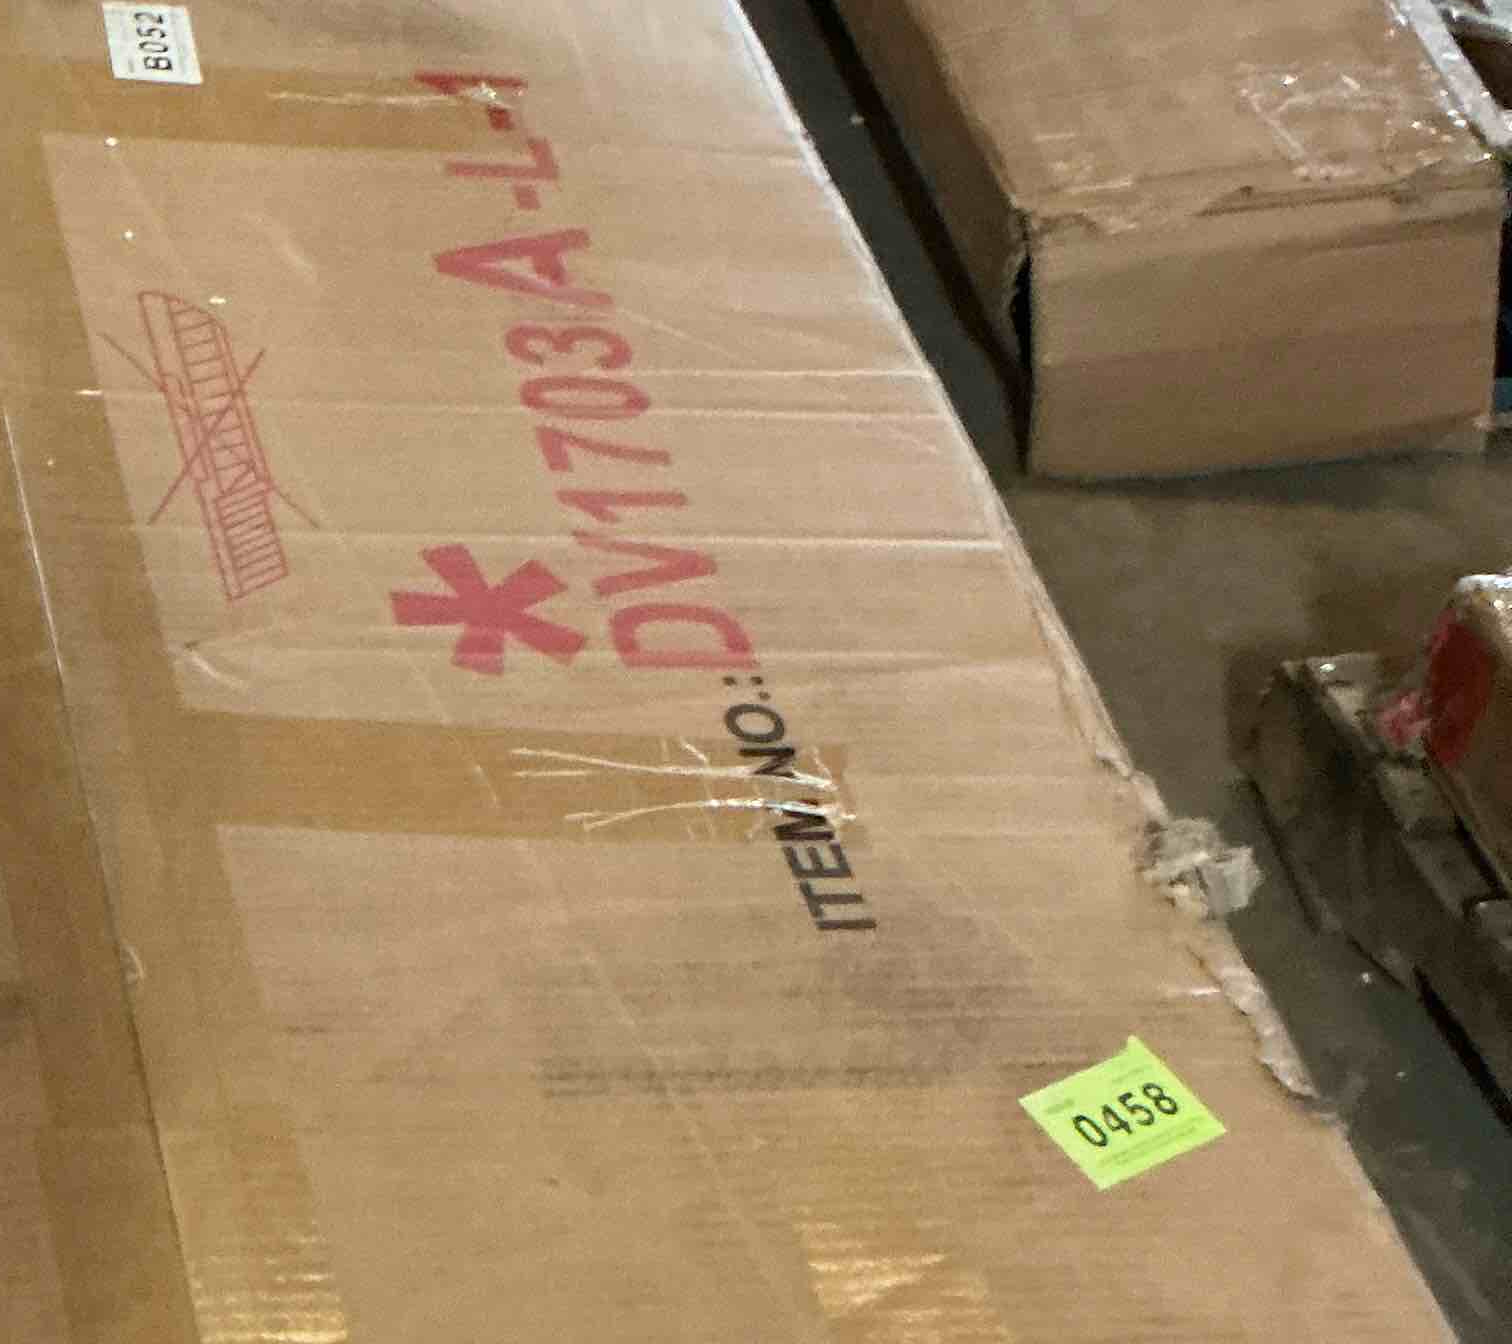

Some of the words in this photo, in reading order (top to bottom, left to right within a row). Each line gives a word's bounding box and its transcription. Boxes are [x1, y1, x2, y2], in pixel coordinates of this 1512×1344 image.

[133, 11, 174, 73] B052
[769, 794, 880, 934] ITEM
[1071, 1080, 1180, 1149] 0458
